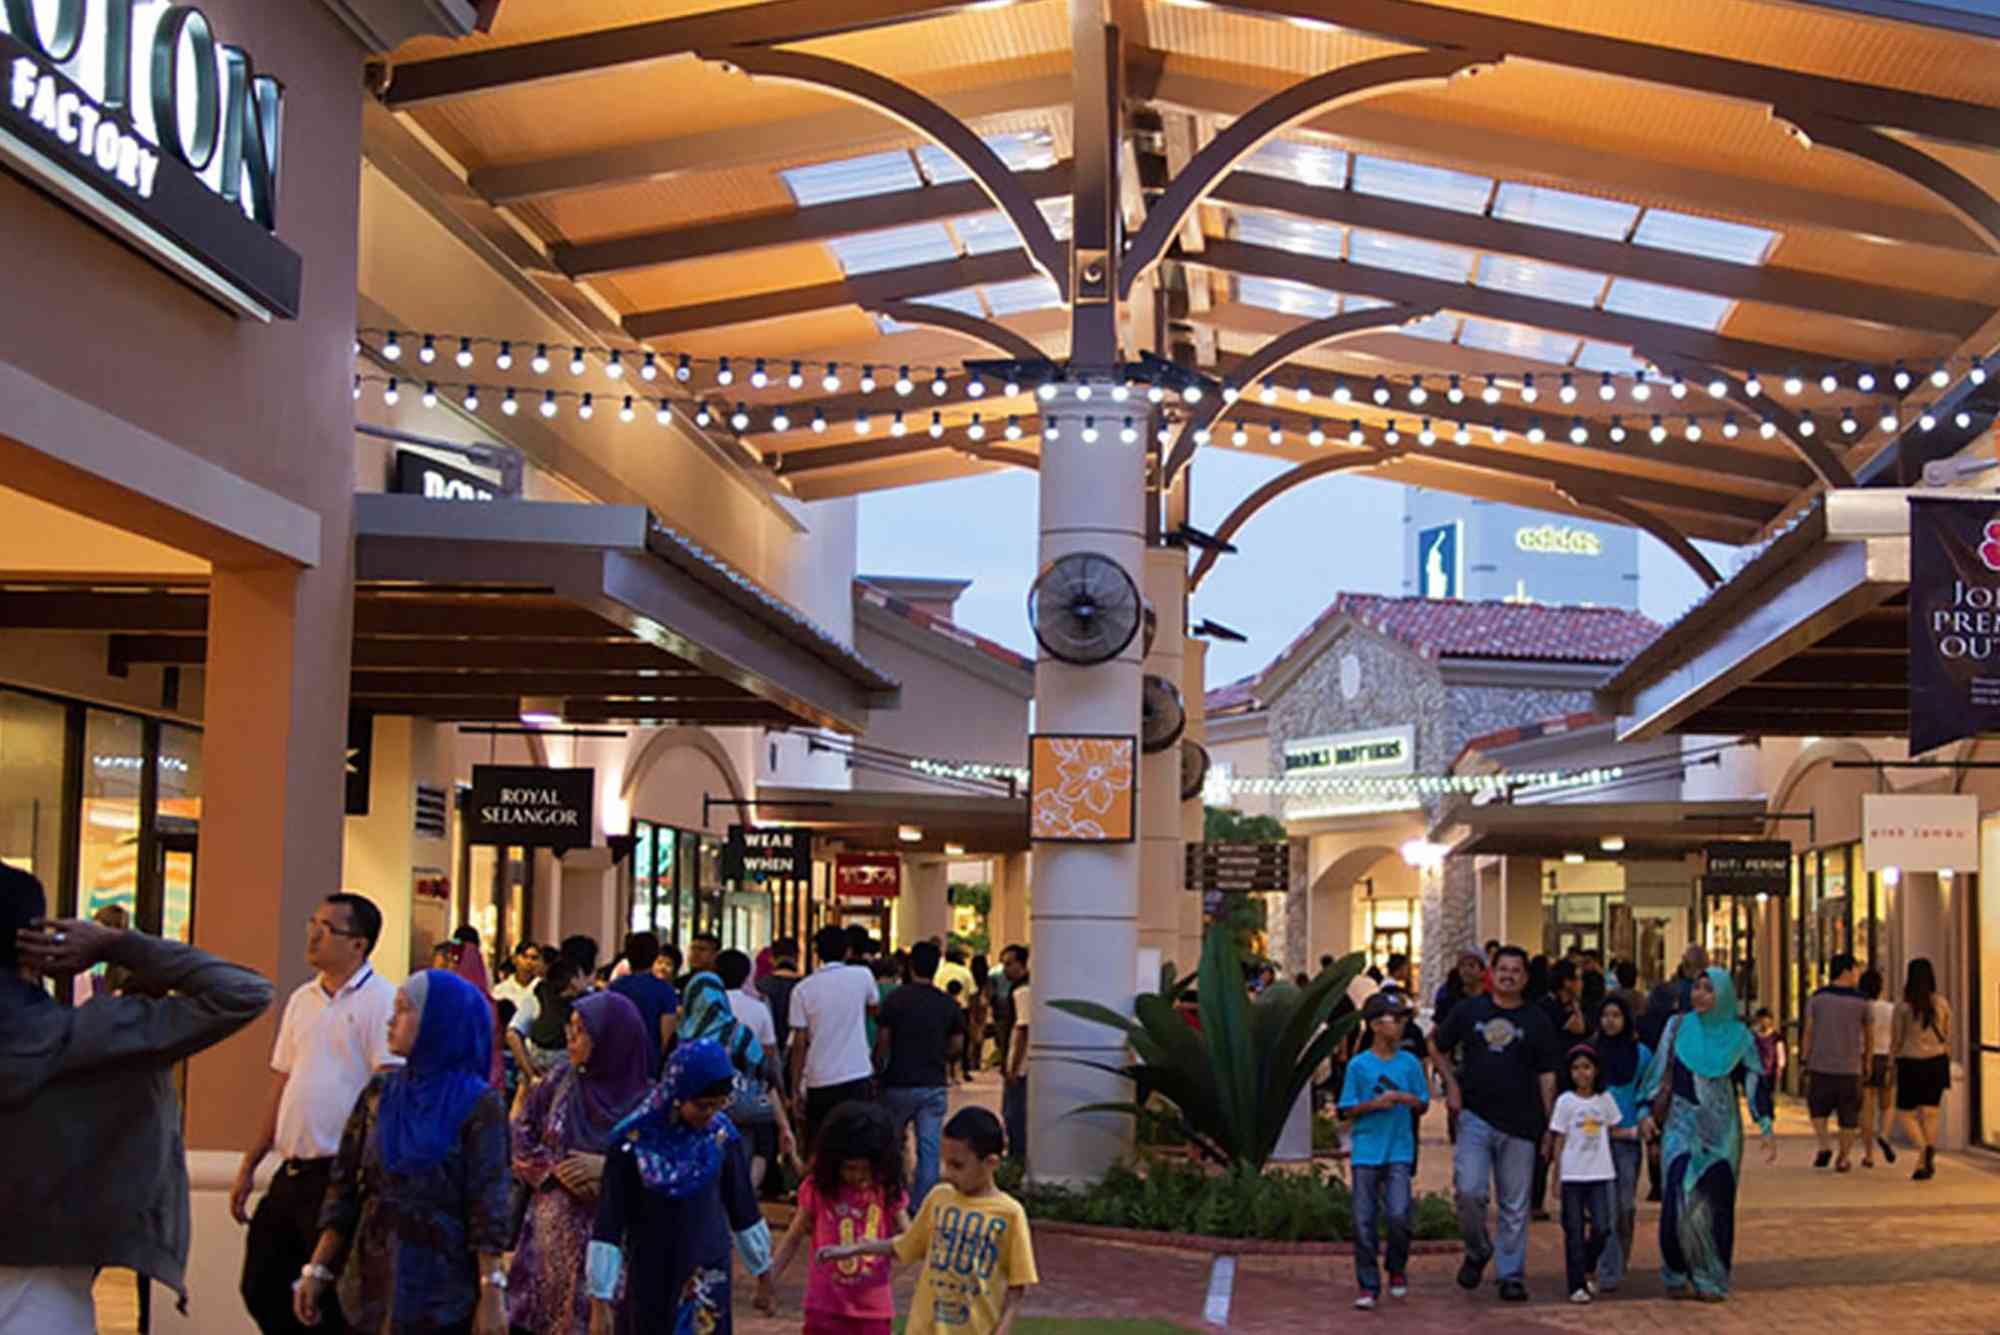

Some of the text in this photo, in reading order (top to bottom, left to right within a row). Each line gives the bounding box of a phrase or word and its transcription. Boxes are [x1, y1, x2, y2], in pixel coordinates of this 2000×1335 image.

[11, 57, 159, 198] FACTORY
[500, 787, 561, 805] ROYAL
[481, 806, 578, 826] SELANGOR
[744, 834, 793, 848] WEAR
[743, 857, 794, 872] WHEN
